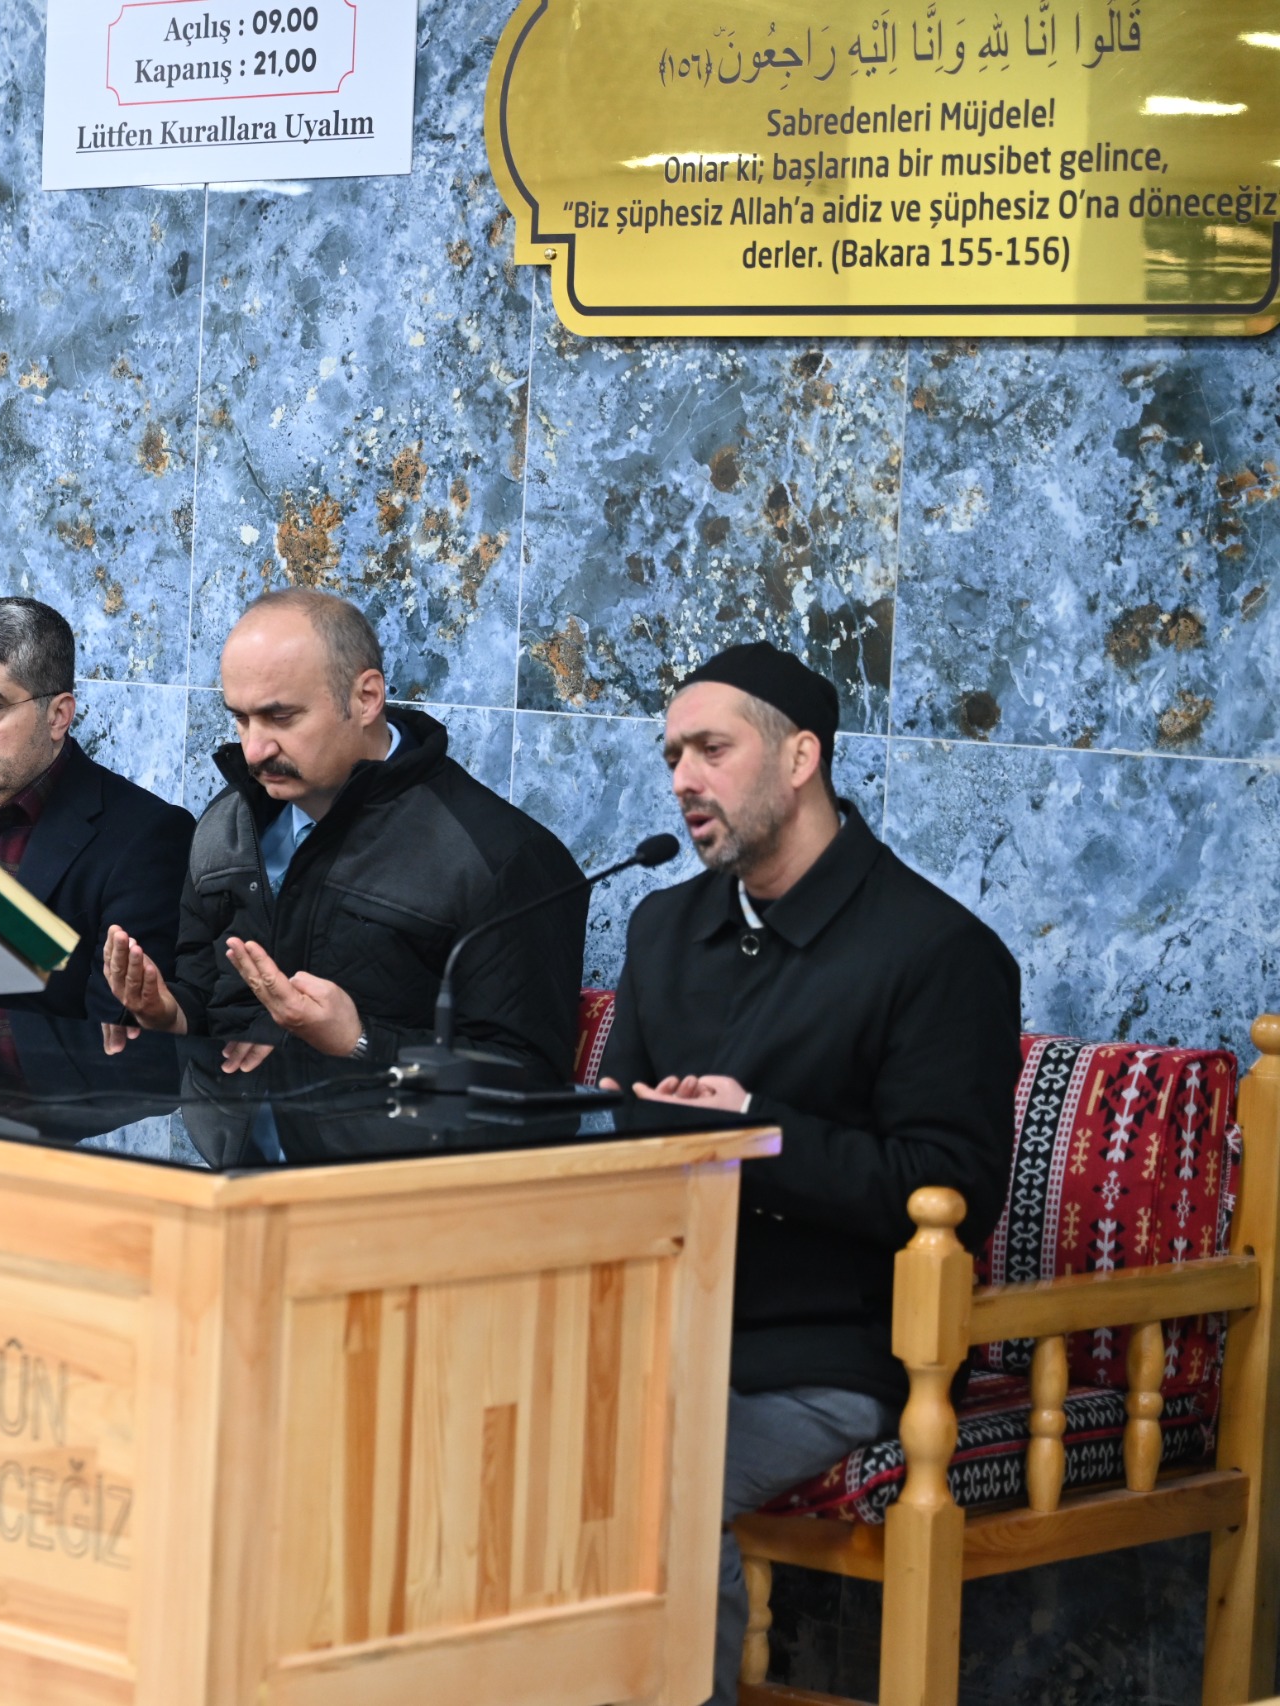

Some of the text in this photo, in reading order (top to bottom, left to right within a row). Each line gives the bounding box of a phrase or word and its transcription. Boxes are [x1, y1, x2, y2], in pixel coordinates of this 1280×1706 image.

[163, 12, 231, 47] Açılış
[252, 6, 319, 35] 09.00
[134, 57, 232, 89] Kapanış
[253, 47, 317, 77] 21,00
[76, 109, 374, 150] Lütfen Kurallara Uyalım
[767, 97, 1056, 137] Sabredenleri Müjdele!
[663, 142, 1168, 187] Onlar ki; başlarına bir musibet gelince,
[616, 198, 723, 234] şüphesiz
[822, 193, 882, 224] aidiz
[891, 198, 920, 222] ve
[929, 189, 1049, 228] şüphesiz
[742, 236, 1070, 274] derler. (Bakara 155-156)
